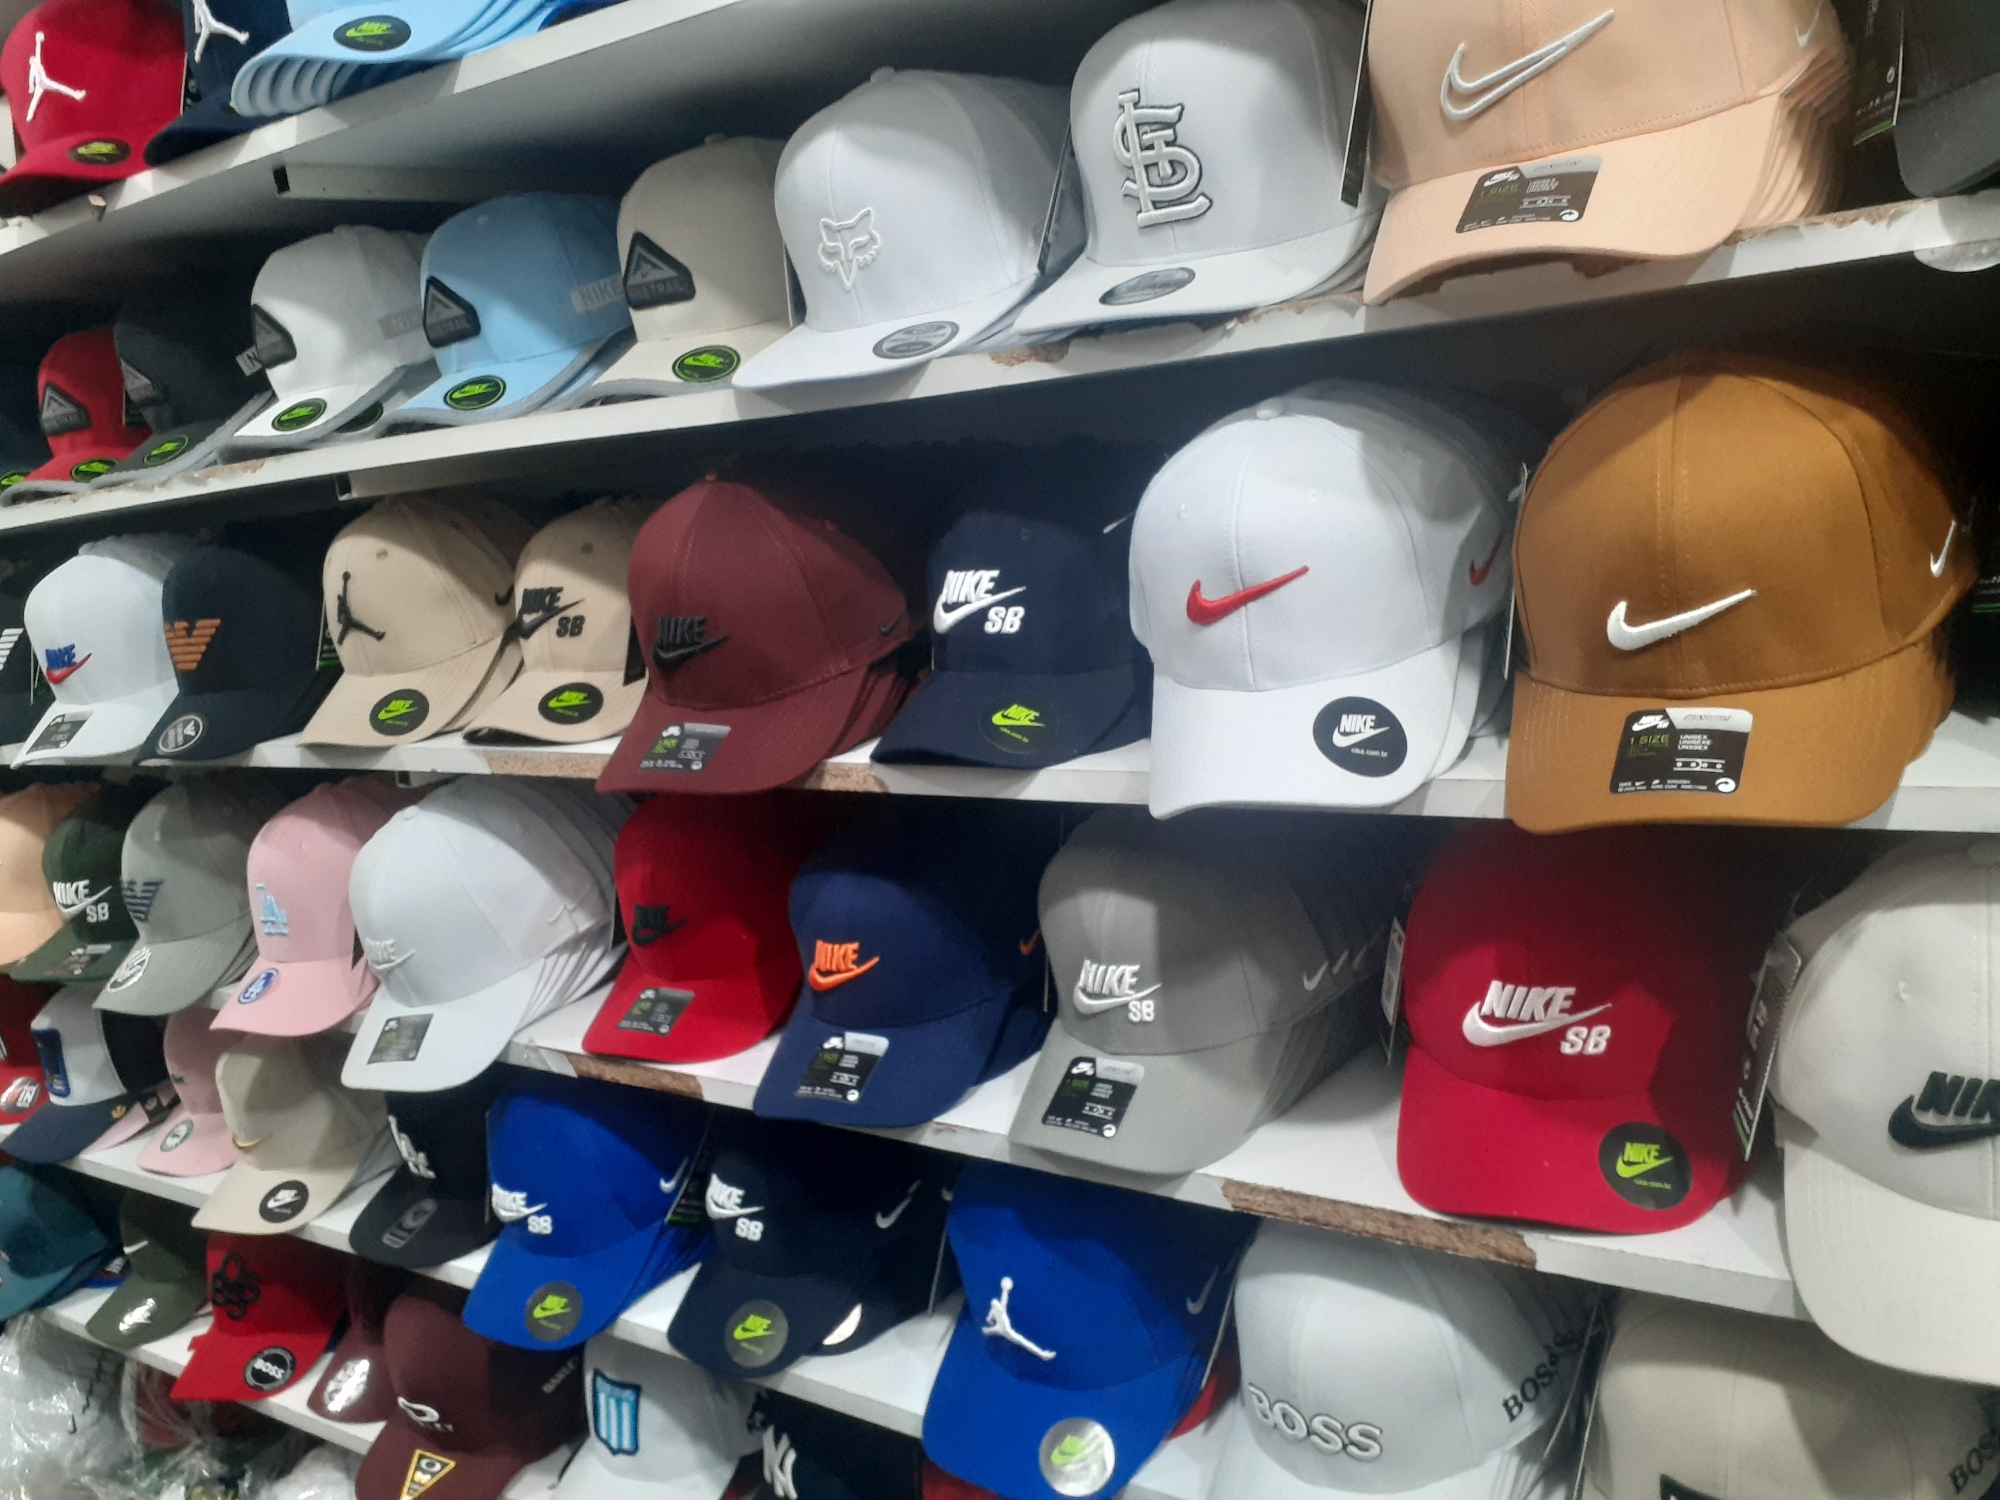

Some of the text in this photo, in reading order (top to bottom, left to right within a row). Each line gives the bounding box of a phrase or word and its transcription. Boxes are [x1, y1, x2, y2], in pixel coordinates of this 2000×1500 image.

[519, 586, 564, 614] NIKE
[942, 570, 1000, 605] NIKE
[555, 614, 586, 638] SB
[657, 615, 706, 646] NIKE
[984, 605, 1026, 634] SB
[1339, 713, 1377, 734] NIKE
[1350, 747, 1389, 759] nike.com.br
[1639, 733, 1670, 747] SIZE
[52, 879, 91, 906] NIKE
[86, 901, 110, 923] SB
[634, 903, 671, 930] NIKE
[813, 939, 860, 972] NIKE
[1078, 958, 1140, 998] NIKE
[1127, 998, 1155, 1023] SB
[1480, 979, 1577, 1022] NIKE
[1560, 1024, 1612, 1055] SB
[527, 1214, 553, 1235] SB
[735, 1217, 764, 1242] SB
[252, 1357, 285, 1380] BOSS
[1247, 1381, 1384, 1463] BOSS
